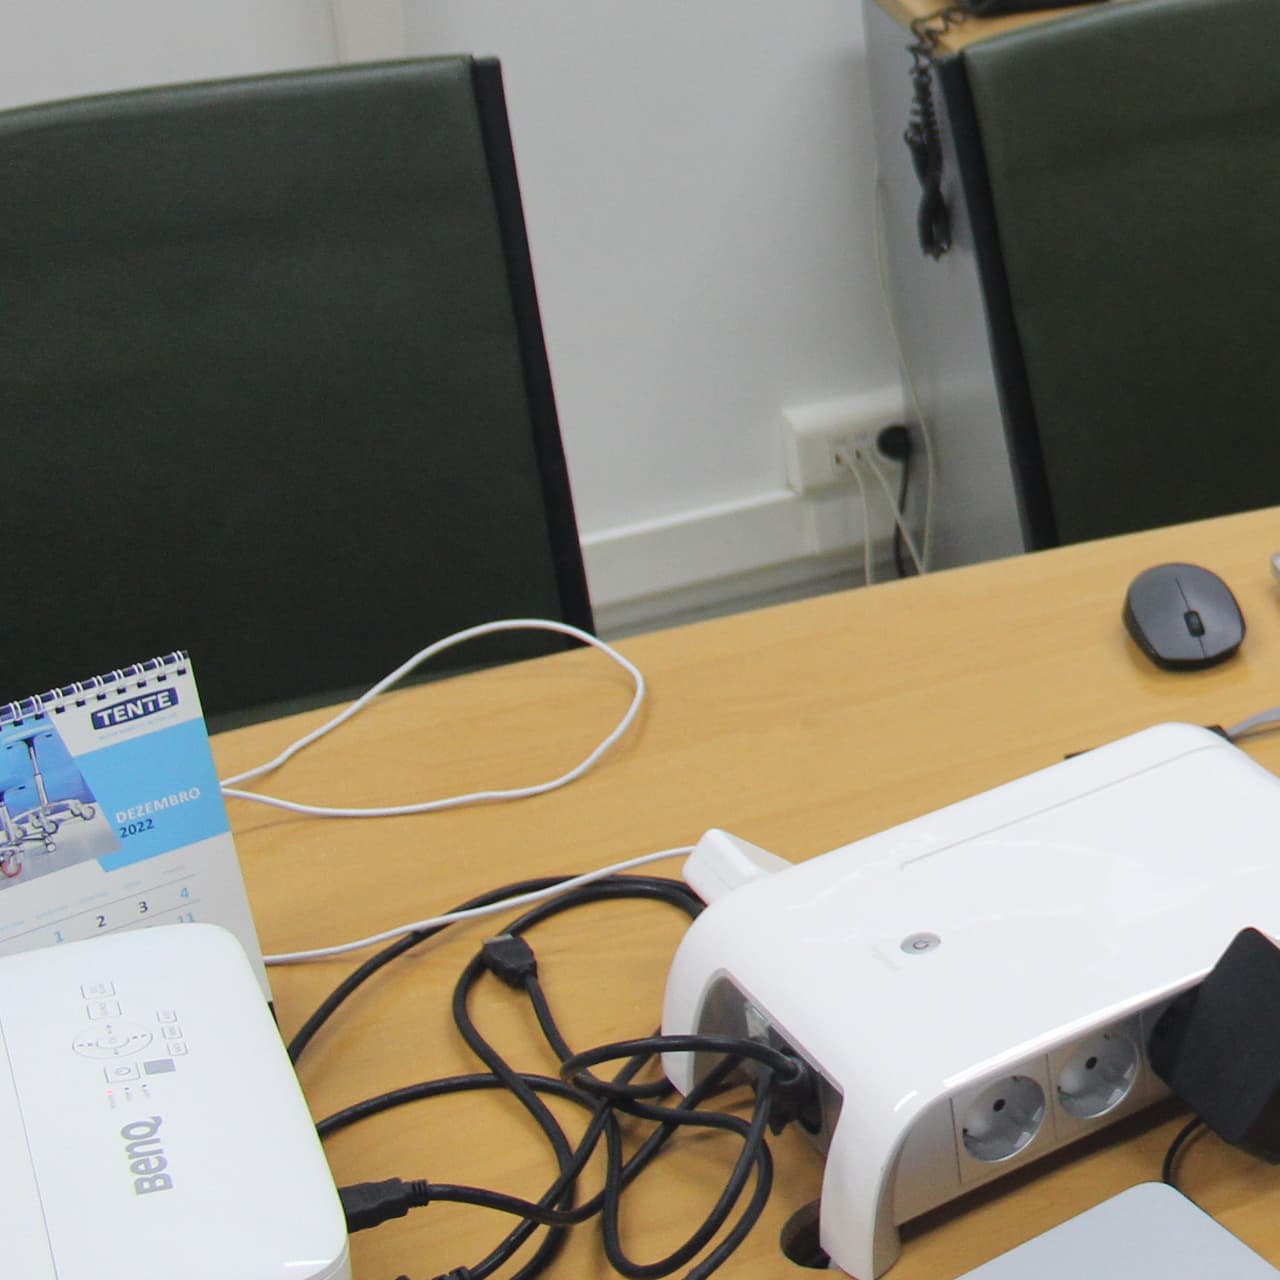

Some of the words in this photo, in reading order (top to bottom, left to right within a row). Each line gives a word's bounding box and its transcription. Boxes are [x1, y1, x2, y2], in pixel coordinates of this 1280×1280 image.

[97, 691, 173, 726] TENTE
[115, 787, 201, 823] DEZEMBRO
[119, 819, 155, 838] 2022
[54, 930, 64, 943] 1
[96, 915, 106, 928] 2
[138, 901, 148, 913] 3
[180, 887, 190, 898] 4
[121, 1115, 173, 1195] BenQ
